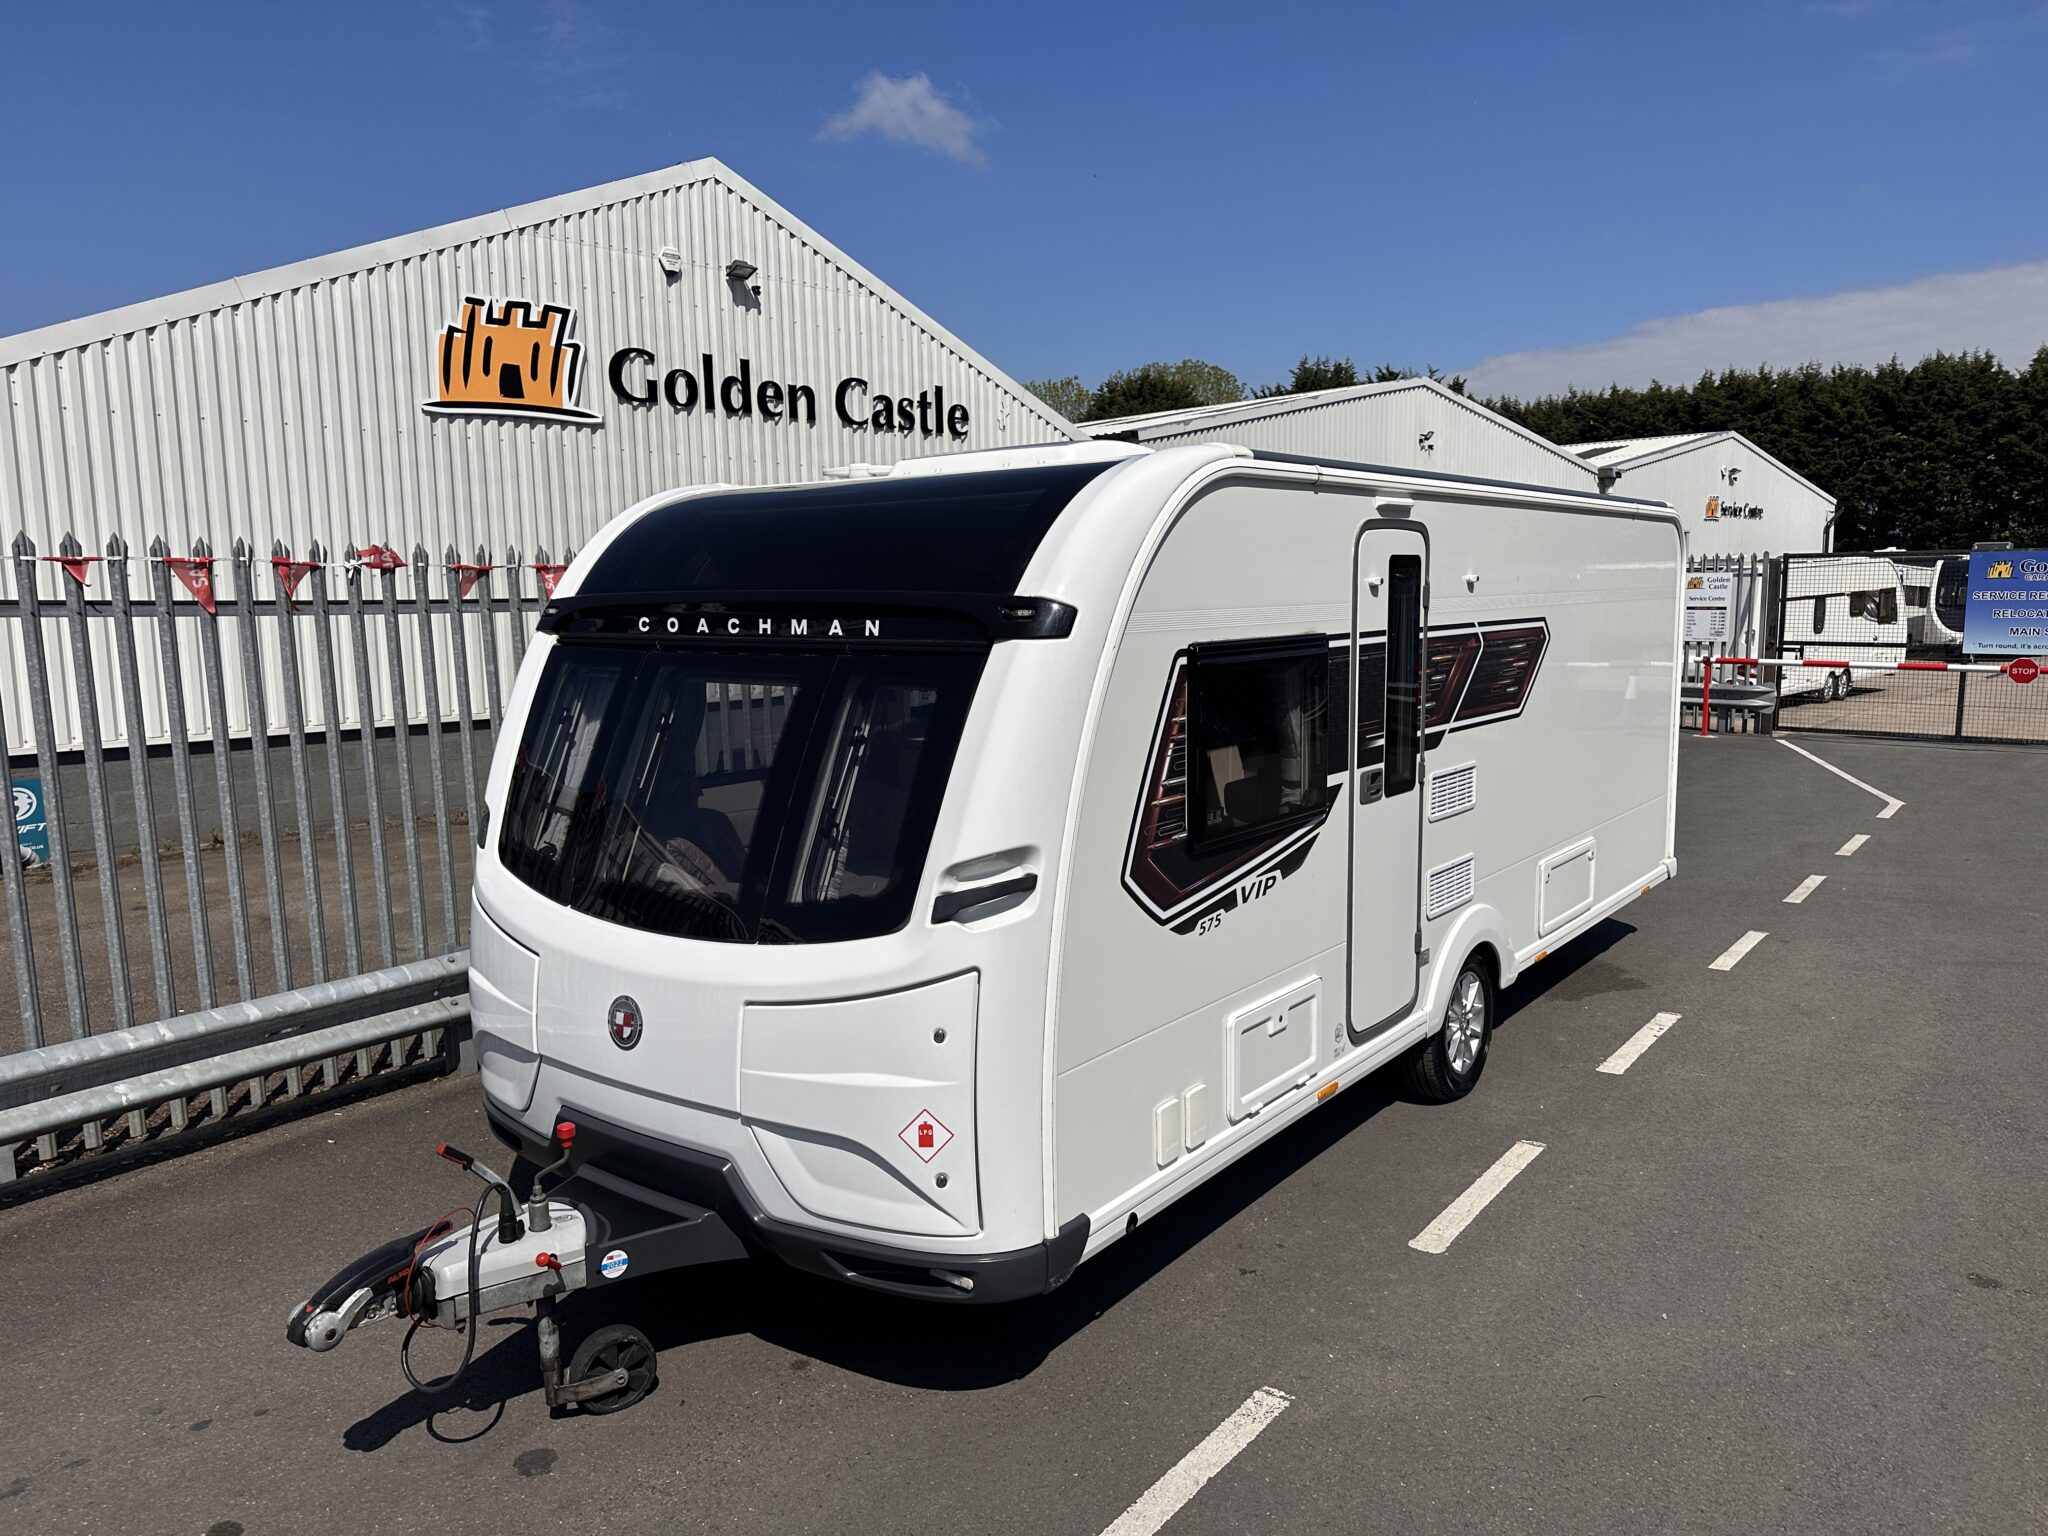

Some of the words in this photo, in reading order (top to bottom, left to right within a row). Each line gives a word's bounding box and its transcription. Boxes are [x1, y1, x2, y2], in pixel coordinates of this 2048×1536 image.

[608, 347, 816, 422] Golden
[835, 377, 969, 437] Castle
[1720, 501, 1742, 518] Service
[1743, 503, 1764, 520] Centre
[1973, 591, 2026, 600] SERVICE
[2029, 591, 2048, 600] RE
[1993, 609, 2048, 618] RELOCA
[638, 616, 880, 637] COACHMAN
[2009, 627, 2041, 636] MAIN
[17, 822, 46, 834] IFT
[1199, 913, 1222, 936] 575
[1241, 875, 1277, 904] VIP
[606, 1258, 624, 1270] 2022
